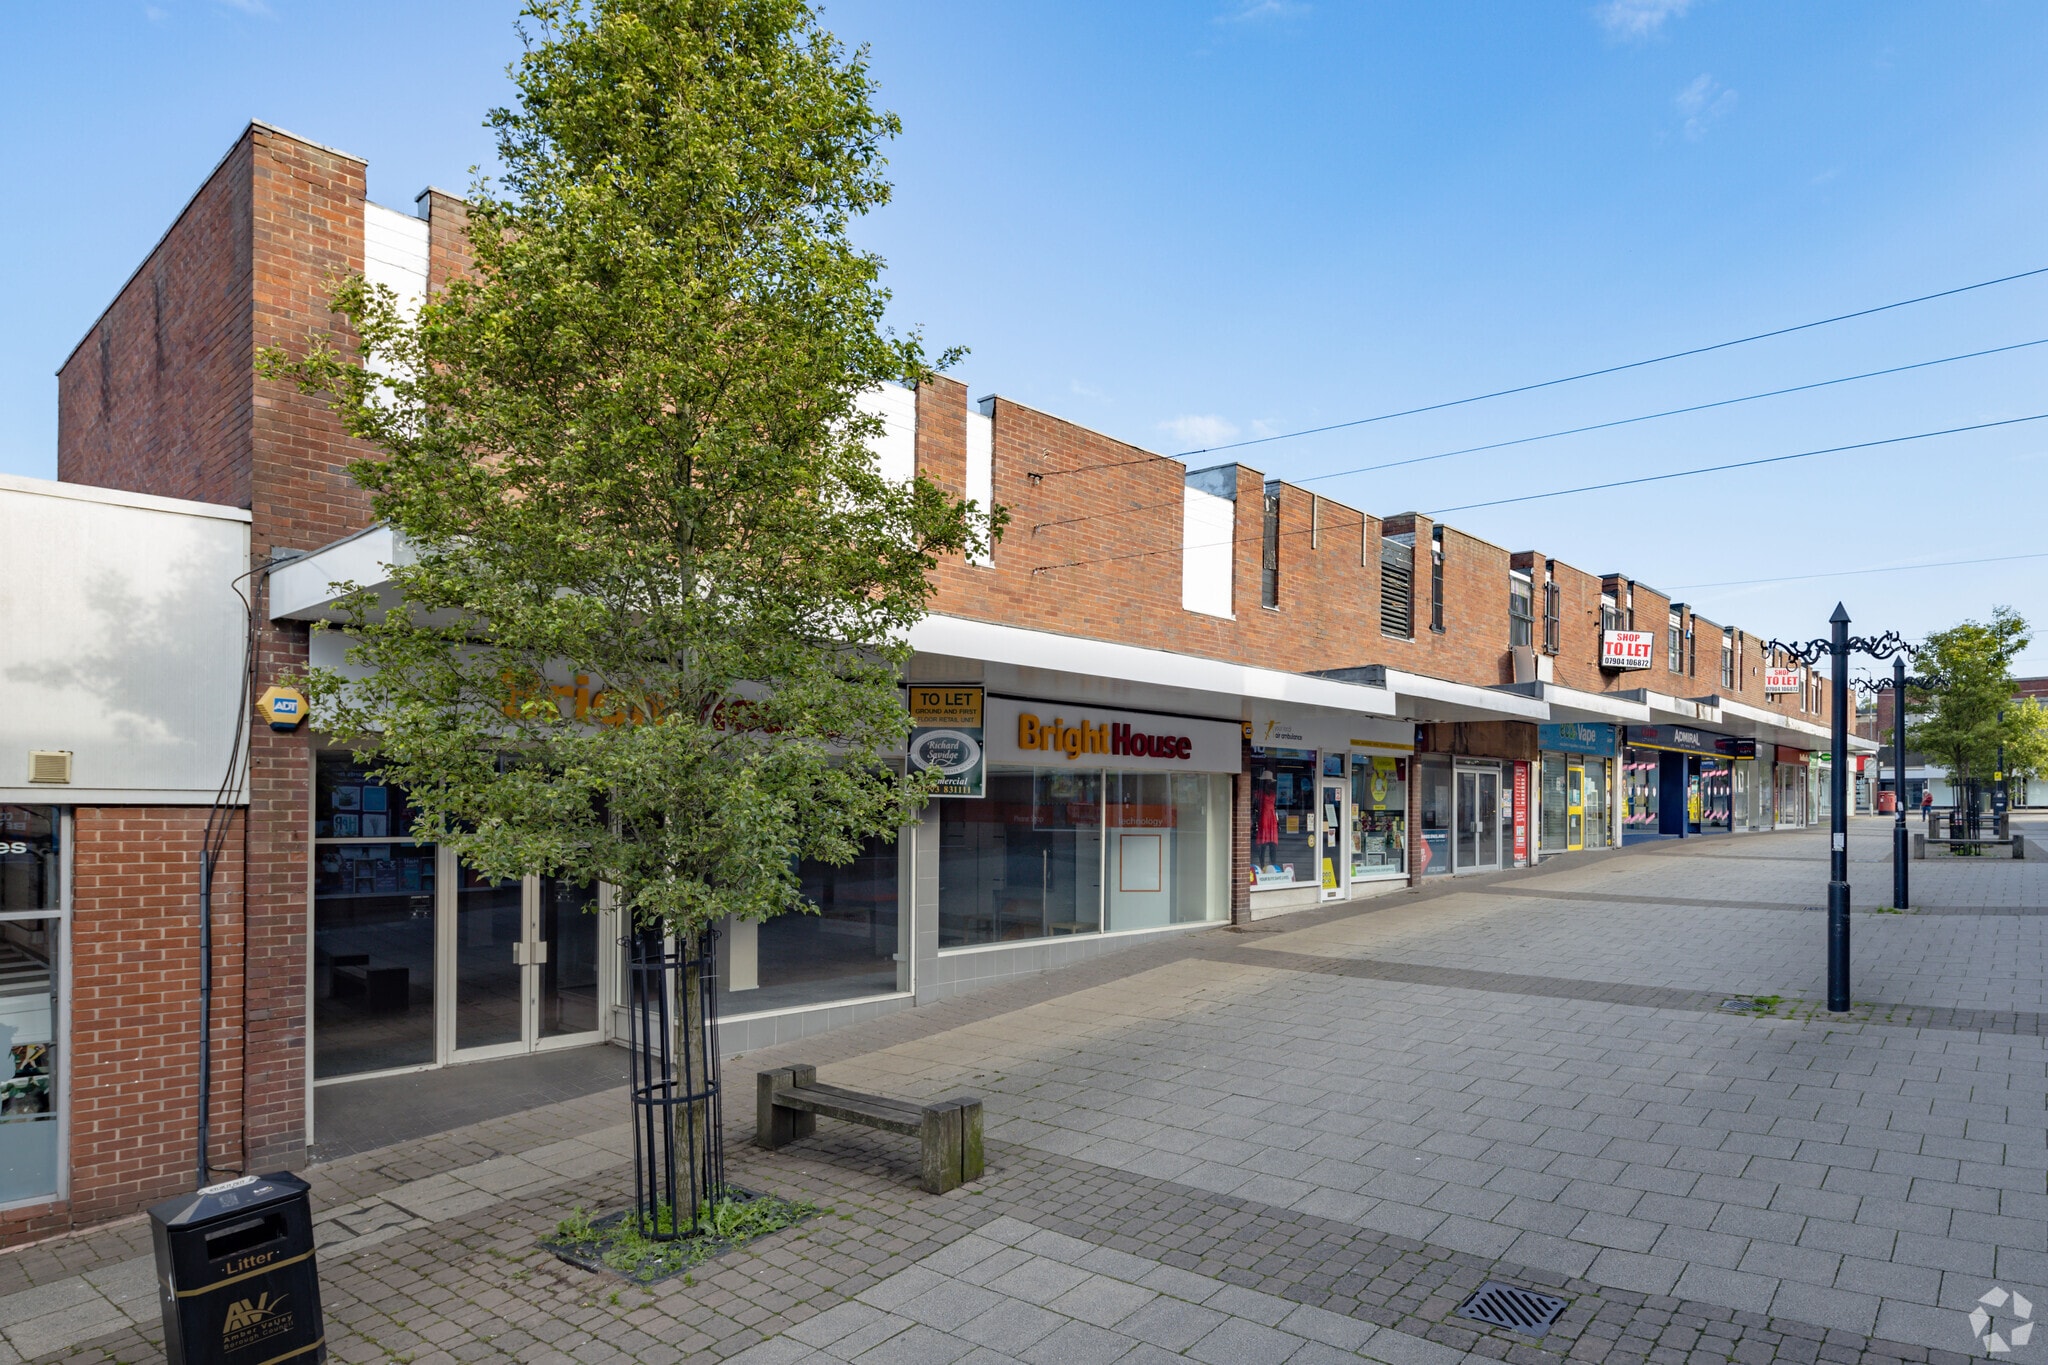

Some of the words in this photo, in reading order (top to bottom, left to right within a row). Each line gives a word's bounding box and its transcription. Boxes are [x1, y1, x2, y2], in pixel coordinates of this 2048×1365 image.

[1616, 633, 1640, 642] SHOP
[1605, 641, 1623, 656] TO
[1627, 643, 1651, 657] LET
[1604, 657, 1625, 665] 07904
[1626, 658, 1649, 667] 106872
[1766, 676, 1779, 685] TO
[1781, 676, 1798, 685] LET
[274, 700, 297, 711] ADT
[920, 692, 940, 706] TO
[945, 692, 973, 706] LET
[1018, 712, 1192, 760] BrightHouse
[1577, 722, 1596, 745] Vape
[1674, 728, 1701, 746] ADMIRAL
[927, 740, 960, 750] Richard
[926, 749, 959, 762] Savidge
[935, 777, 968, 786] mercial
[943, 785, 971, 794] 831111
[225, 1250, 275, 1275] Litter
[222, 1291, 269, 1334] AV
[223, 1327, 257, 1344] Amber
[260, 1314, 293, 1330] Valley
[223, 1333, 260, 1350] Borough
[262, 1320, 295, 1336] Council
